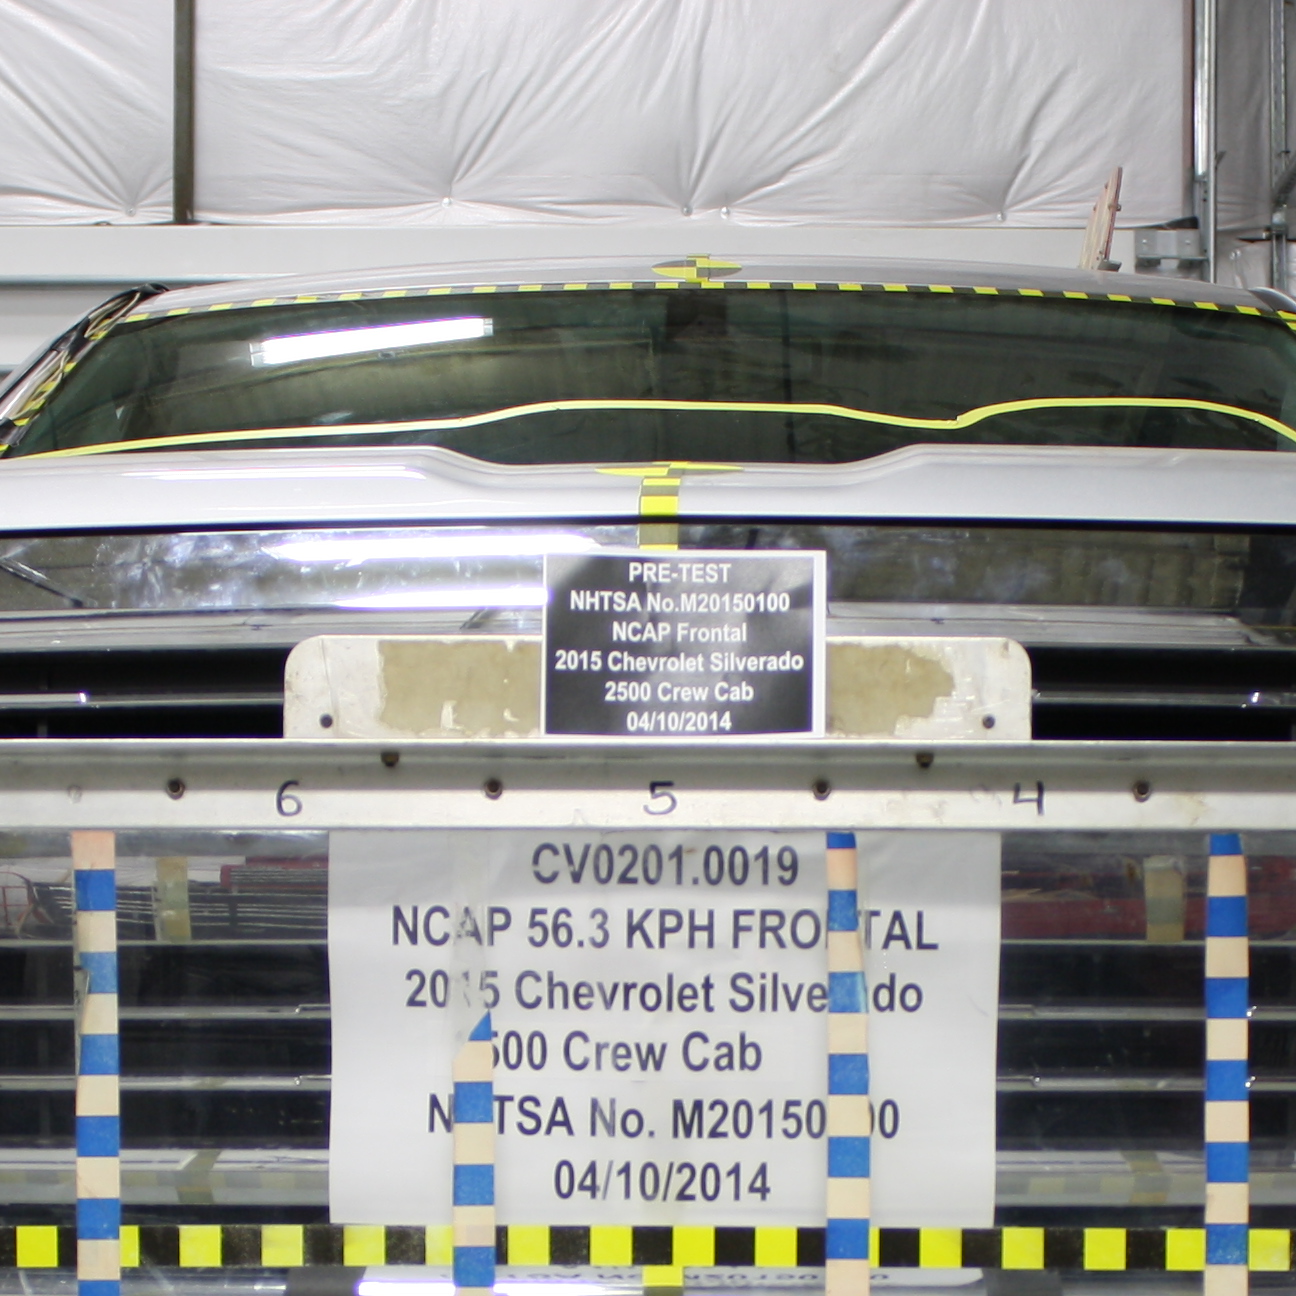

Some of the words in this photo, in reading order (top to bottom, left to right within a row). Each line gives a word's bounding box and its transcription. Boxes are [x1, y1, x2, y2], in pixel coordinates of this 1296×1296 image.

[628, 562, 732, 583] PRE-TEST
[570, 590, 642, 612] NHTSA
[646, 591, 791, 613] No.M20150100
[611, 622, 671, 642] NCAP
[677, 622, 748, 642] Frontal
[554, 649, 603, 671] 2015
[607, 650, 705, 672] Chevrolet
[710, 650, 805, 672] Silverado
[604, 681, 652, 702] 2500
[657, 681, 710, 702] Crew
[714, 681, 755, 701] Cab
[626, 711, 733, 732] 04/10/2014
[275, 780, 305, 818] 6
[643, 781, 679, 817] 5
[1011, 781, 1048, 817] 4
[531, 843, 800, 887] CV0201.0019
[391, 905, 513, 949] NCAP
[528, 907, 610, 949] 56.3
[626, 907, 715, 951] KPH
[731, 907, 940, 952] FROTAL
[514, 971, 716, 1014] Chevrolet
[729, 971, 924, 1014] Silvedo
[563, 1031, 668, 1073] Crew
[681, 1031, 763, 1073] Cab
[428, 1093, 575, 1138] NTSA
[590, 1097, 656, 1140] No.
[672, 1098, 901, 1141] M201500
[553, 1160, 771, 1203] 04/10/2014
